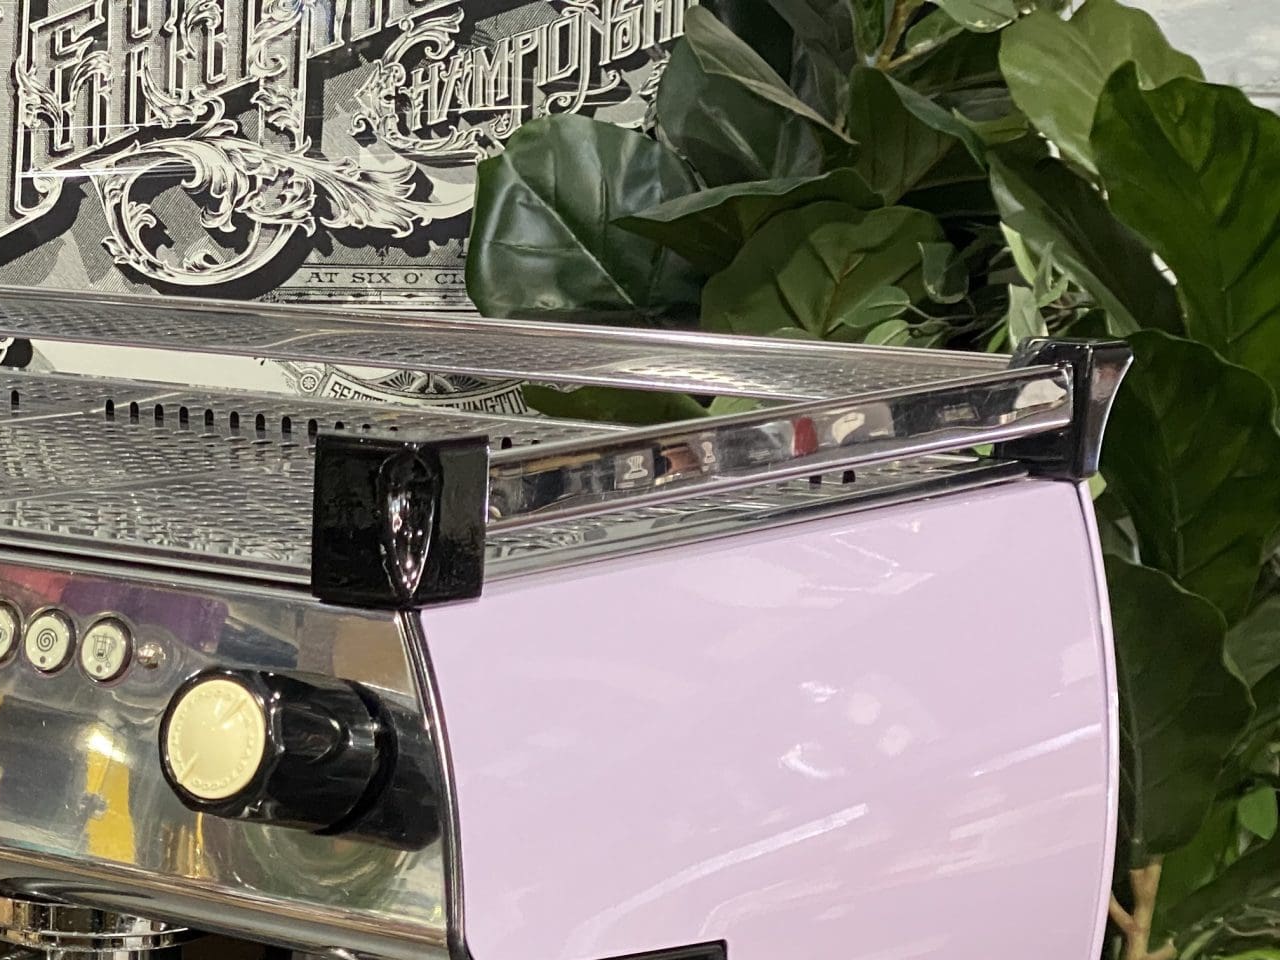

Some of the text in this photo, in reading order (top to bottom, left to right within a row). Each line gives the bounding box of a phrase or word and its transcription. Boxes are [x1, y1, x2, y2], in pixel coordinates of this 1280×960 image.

[347, 0, 698, 160] CHAMPIONSHI
[306, 272, 340, 284] AT
[351, 272, 392, 284] SIX
